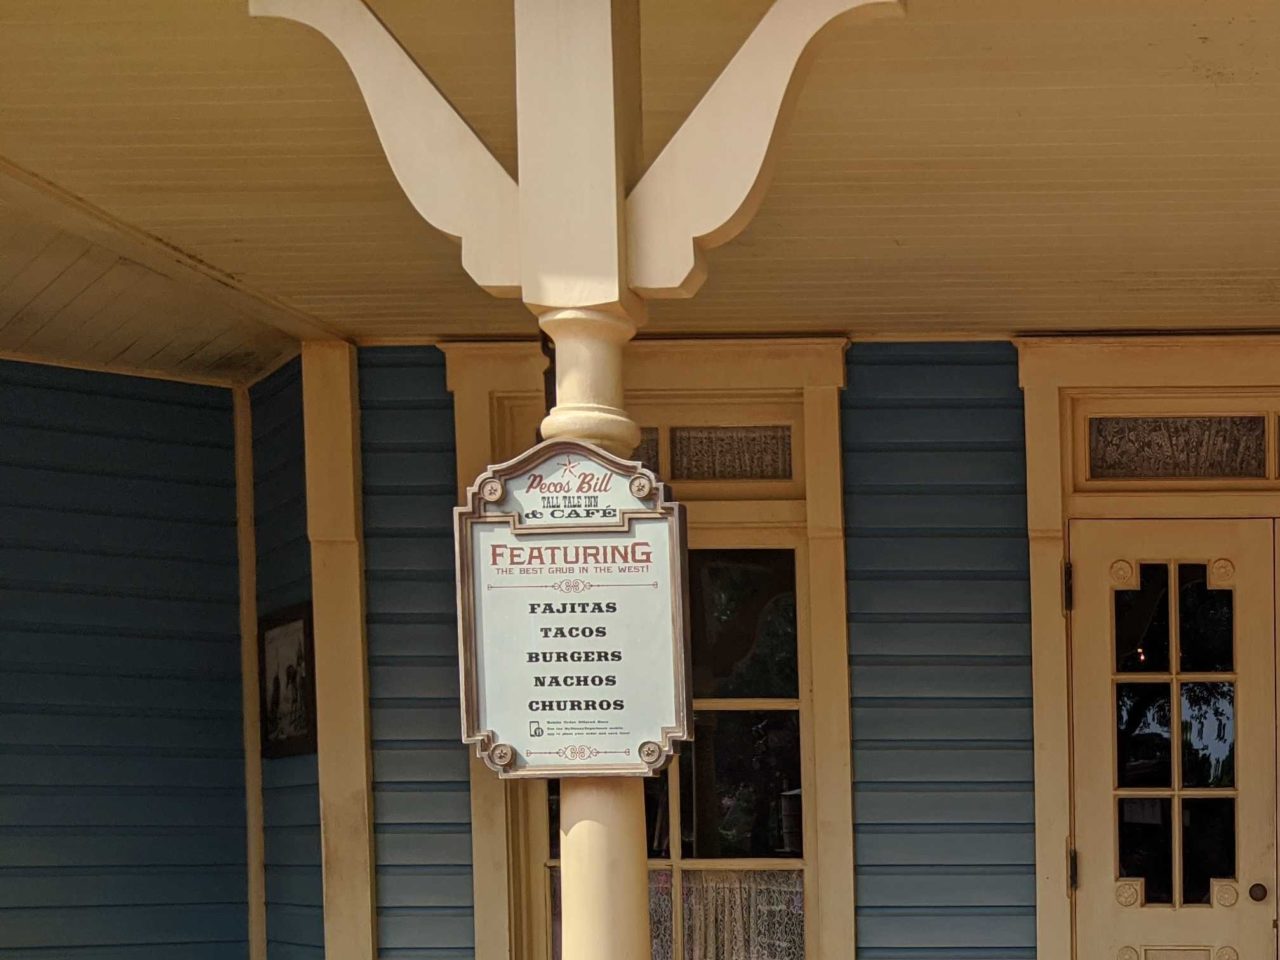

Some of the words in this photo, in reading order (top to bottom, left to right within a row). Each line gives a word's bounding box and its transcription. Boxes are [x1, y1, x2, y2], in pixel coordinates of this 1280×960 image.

[527, 473, 571, 494] Pecos
[576, 471, 613, 493] Bill
[541, 496, 561, 508] TALL
[563, 495, 582, 508] TALE
[584, 495, 599, 507] INN
[524, 509, 543, 519] &
[550, 505, 617, 519] CAFÉ
[490, 541, 652, 566] FEATURING
[495, 567, 514, 575] THE
[519, 567, 544, 575] BEST
[548, 566, 575, 574] GRUB
[578, 566, 589, 574] IN
[594, 565, 613, 573] THE
[618, 565, 649, 573] WEST!
[528, 602, 617, 614] FAJITAS
[540, 626, 607, 638] TACOS
[526, 651, 622, 663] BURGERS
[534, 675, 617, 687] NACHOS
[528, 699, 625, 711] CHURROS
